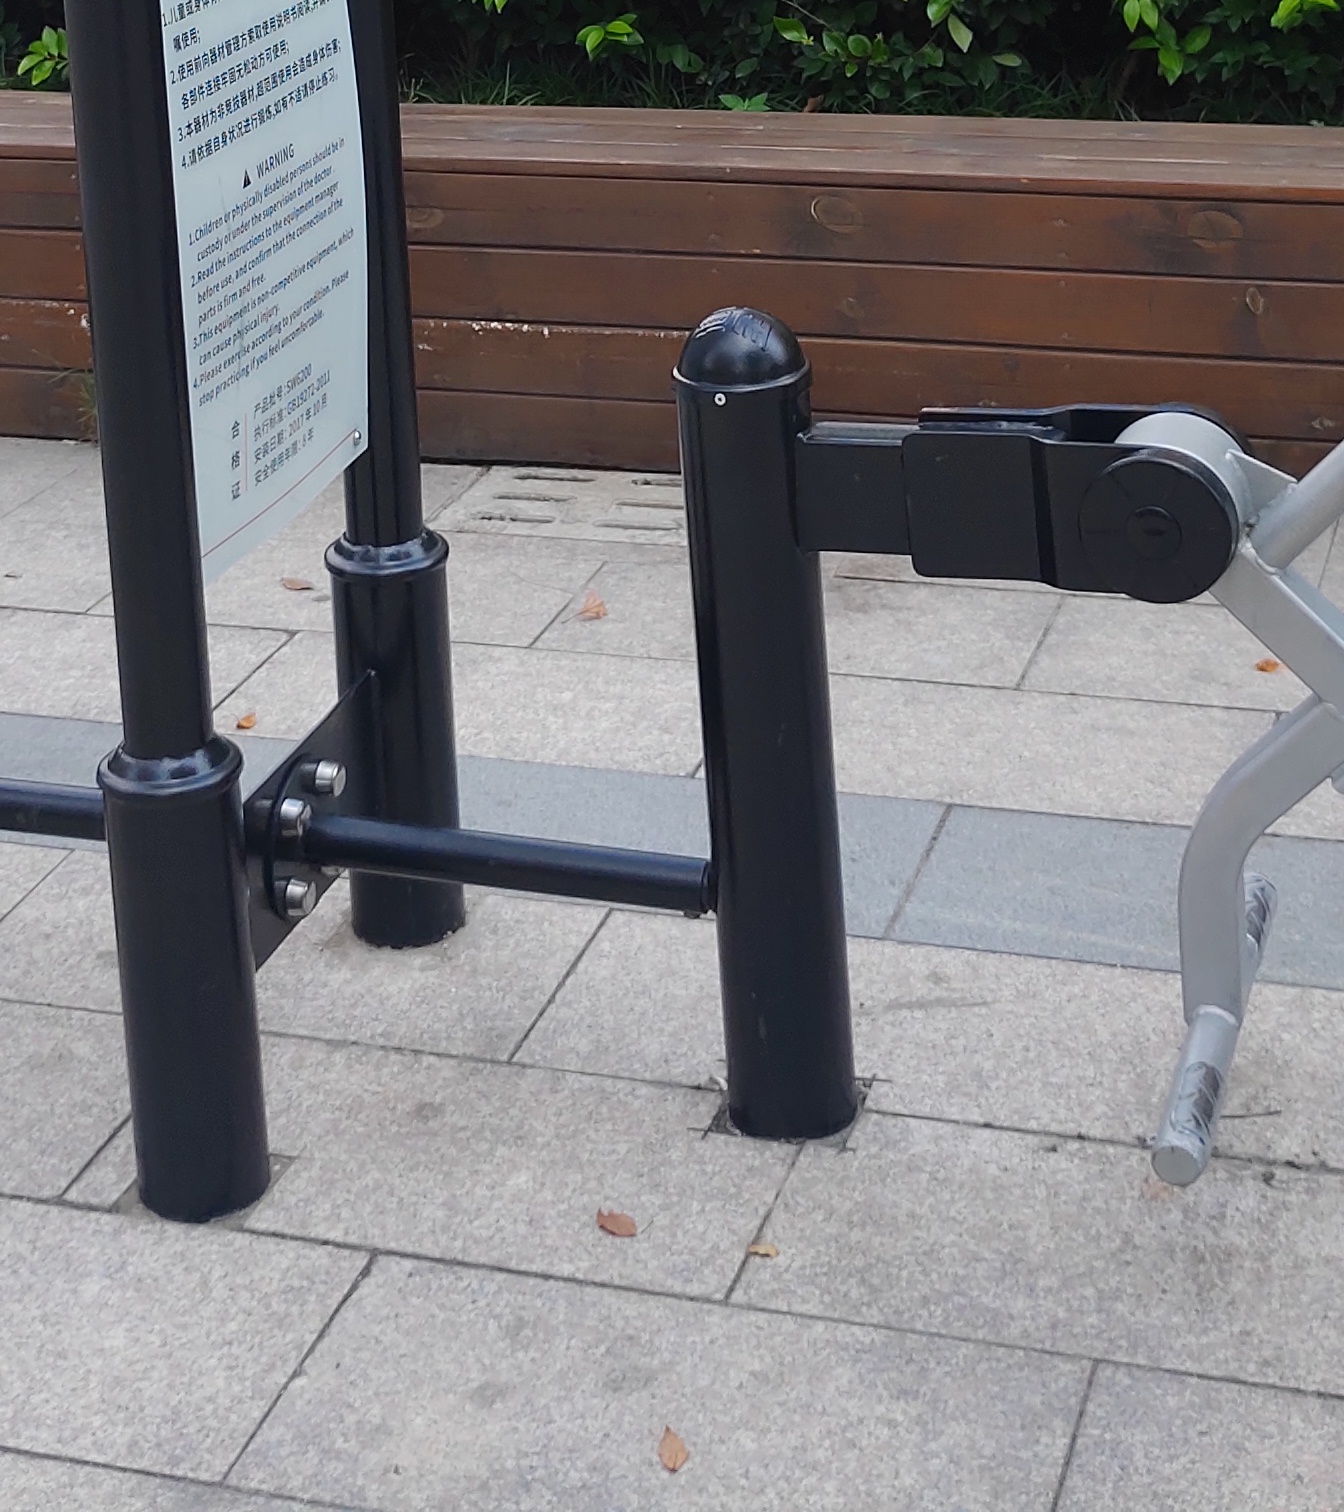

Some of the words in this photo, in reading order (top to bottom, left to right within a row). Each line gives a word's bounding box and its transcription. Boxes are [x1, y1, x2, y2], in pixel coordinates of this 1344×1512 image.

[189, 217, 223, 246] 1.Children
[224, 211, 231, 223] or
[232, 190, 263, 222] physically
[264, 171, 289, 198] disabled
[290, 159, 312, 184] persons
[313, 144, 331, 166] should
[331, 142, 339, 153] be
[339, 137, 344, 148] in
[256, 143, 295, 179] WARNING
[191, 261, 214, 288] 2.Read
[215, 257, 226, 272] the
[226, 231, 265, 264] instructions
[265, 227, 272, 238] to
[272, 220, 282, 234] the
[283, 197, 314, 226] equipment
[315, 181, 339, 204] manager
[197, 237, 223, 262] custody
[224, 232, 231, 244] or
[232, 220, 251, 240] under
[251, 213, 262, 227] the
[263, 190, 297, 220] supervision
[298, 181, 303, 196] of
[304, 179, 314, 192] the
[198, 283, 220, 304] before
[221, 274, 234, 289] use,
[236, 261, 248, 280] and
[248, 248, 272, 271] confirm
[273, 237, 286, 254] that
[286, 231, 296, 245] the
[296, 209, 327, 238] connection
[328, 201, 334, 215] of
[334, 198, 343, 211] the
[193, 327, 214, 350] 3.This
[214, 302, 250, 335] equipment
[251, 299, 257, 309] is
[338, 228, 354, 246] which
[199, 306, 216, 329] parts
[217, 300, 223, 312] is
[224, 292, 238, 308] firm
[239, 279, 251, 298] and
[252, 274, 266, 289] free.
[223, 344, 250, 370] exercise
[252, 321, 282, 350] according
[282, 316, 289, 328] to
[289, 306, 303, 325] your
[332, 270, 349, 290] Please
[199, 351, 212, 366] can
[213, 337, 232, 357] cause
[233, 314, 260, 345] physical
[261, 304, 279, 323] injury.
[199, 389, 214, 407] stop
[251, 356, 256, 371] if
[256, 351, 268, 370] you
[269, 339, 281, 357] feel
